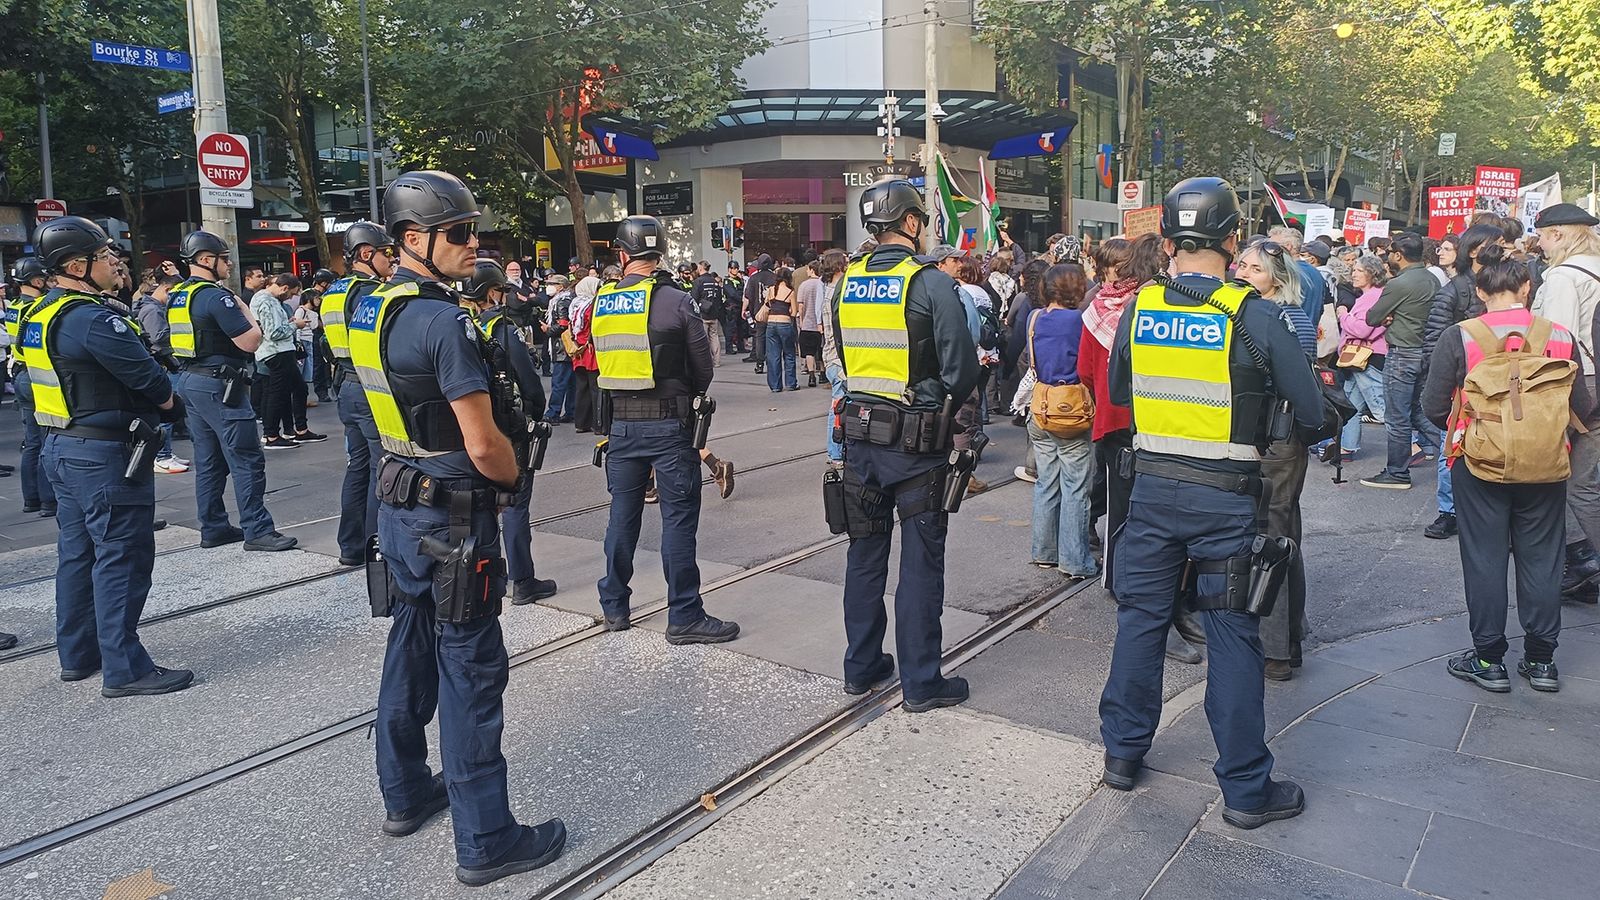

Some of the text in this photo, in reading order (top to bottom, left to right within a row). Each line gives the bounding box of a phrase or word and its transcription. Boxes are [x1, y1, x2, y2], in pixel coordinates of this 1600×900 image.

[95, 43, 158, 61] Bourke St
[215, 141, 232, 152] NO
[207, 168, 243, 180] ENTRY
[842, 172, 873, 186] TELS
[1480, 171, 1516, 181] ISRAEL
[1479, 180, 1515, 188] MURDERS
[1431, 190, 1474, 198] MEDICINE
[1475, 187, 1517, 197] NURSES
[1437, 197, 1469, 208] NOT
[1431, 208, 1473, 217] MISSILES
[844, 279, 900, 299] Police
[597, 295, 643, 312] Police
[1137, 316, 1221, 343] Police
